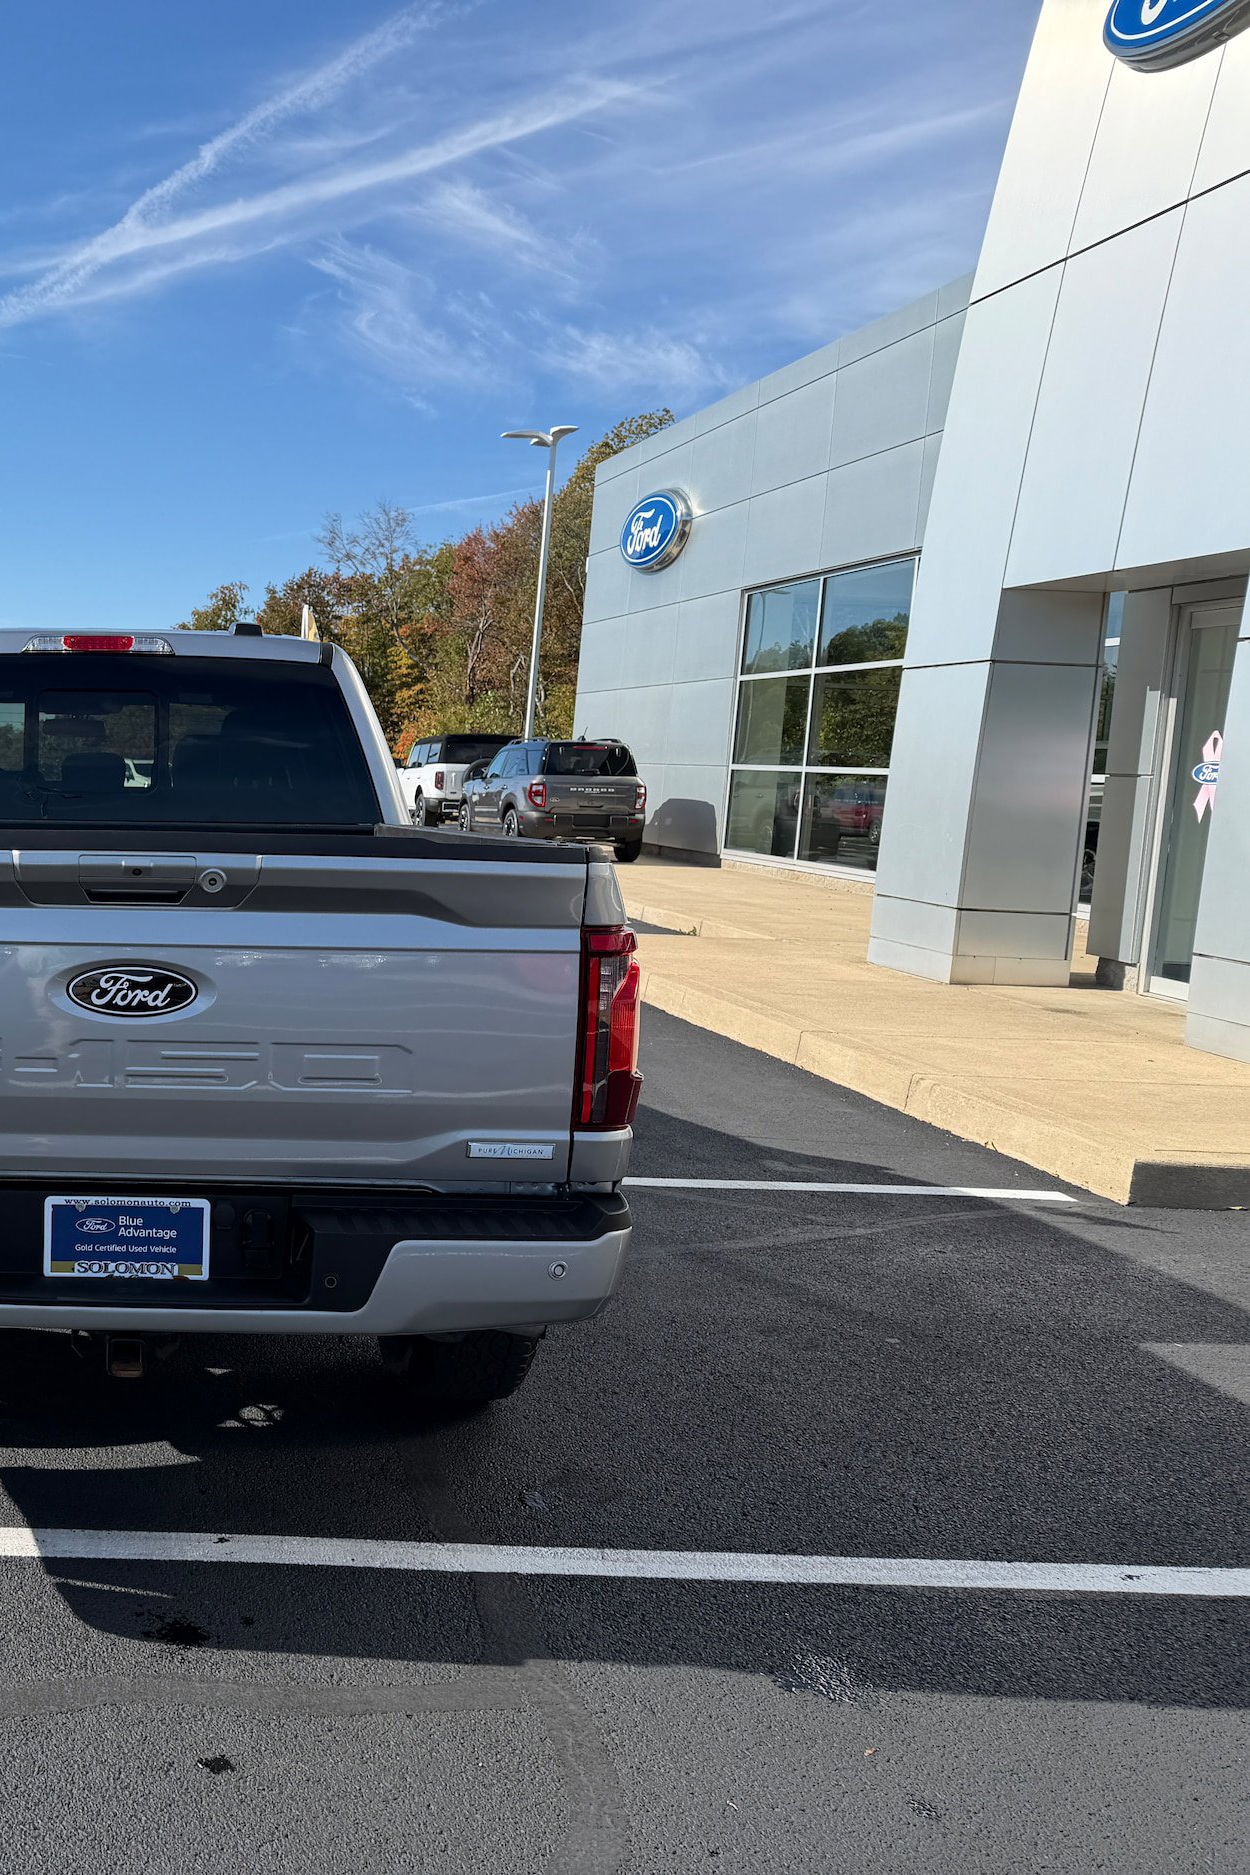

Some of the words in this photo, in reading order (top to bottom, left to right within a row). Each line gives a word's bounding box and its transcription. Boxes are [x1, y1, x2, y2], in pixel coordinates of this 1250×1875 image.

[627, 508, 663, 555] Ford
[1199, 764, 1219, 781] For
[91, 973, 174, 1007] Ford
[64, 1198, 192, 1208] www.solomonauto.com
[83, 1220, 107, 1231] Ford
[118, 1216, 144, 1226] Blue
[118, 1227, 178, 1239] Advantage
[75, 1244, 93, 1252] Gold
[94, 1244, 127, 1252] Certified
[129, 1245, 148, 1253] Used
[150, 1245, 177, 1254] Vehicle
[76, 1261, 177, 1275] SOLOMON
